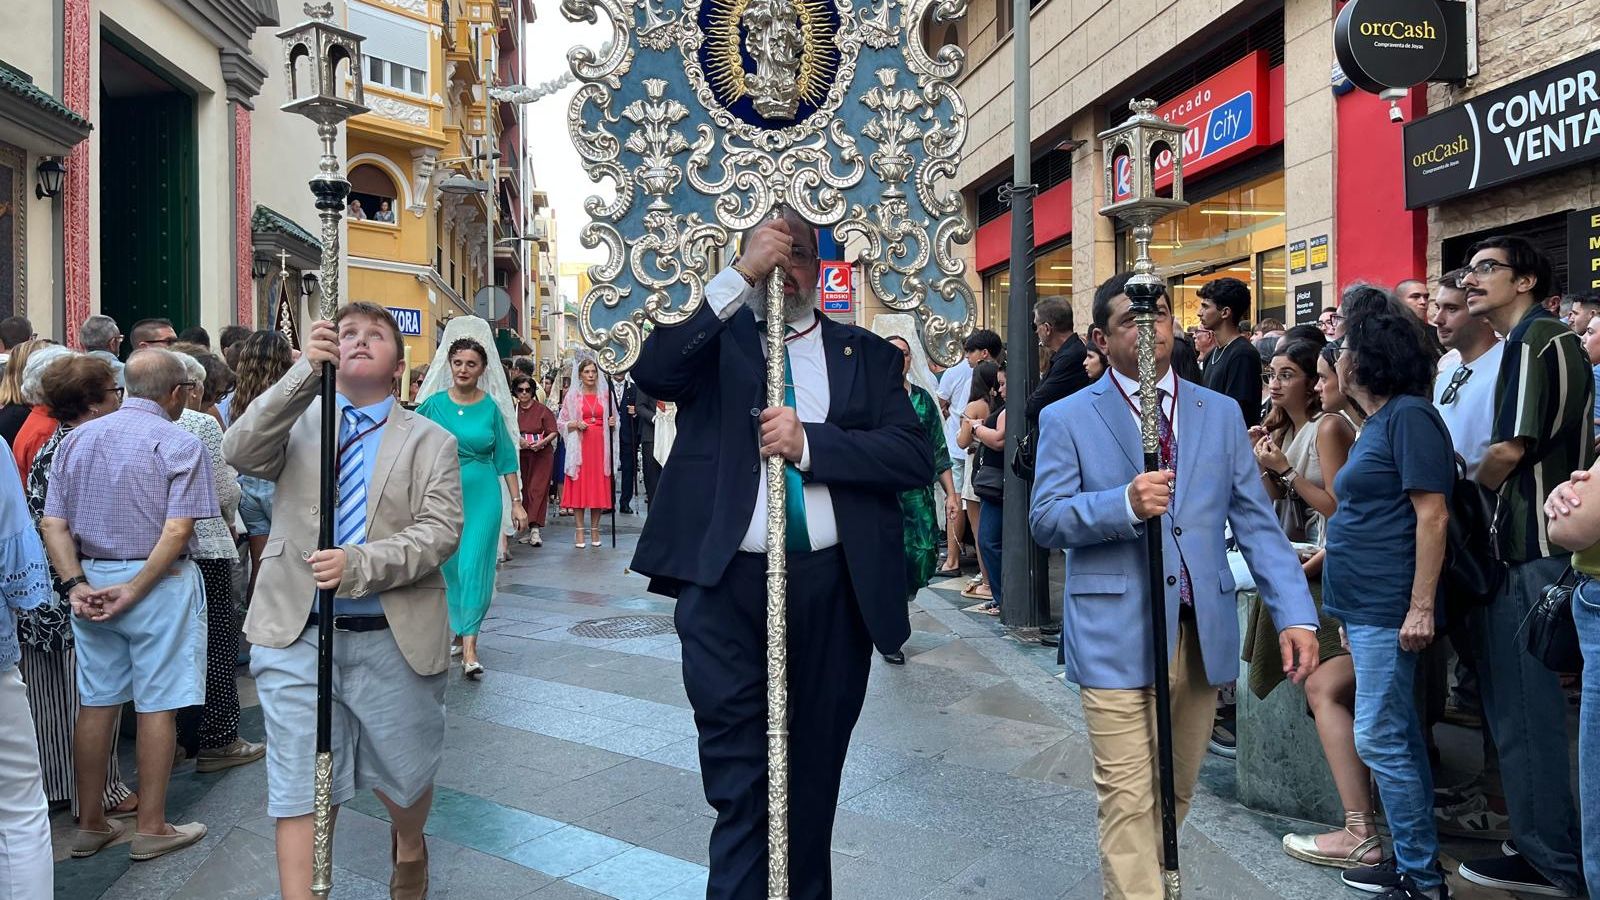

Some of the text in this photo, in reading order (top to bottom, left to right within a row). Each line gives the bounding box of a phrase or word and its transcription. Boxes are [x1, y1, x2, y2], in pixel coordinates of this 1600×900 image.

[1360, 20, 1436, 40] oroCash
[1163, 89, 1211, 123] ercado
[1486, 69, 1600, 134] COMPR
[1213, 108, 1243, 141] city
[1503, 108, 1600, 166] VENTA
[1412, 134, 1469, 167] oroCash
